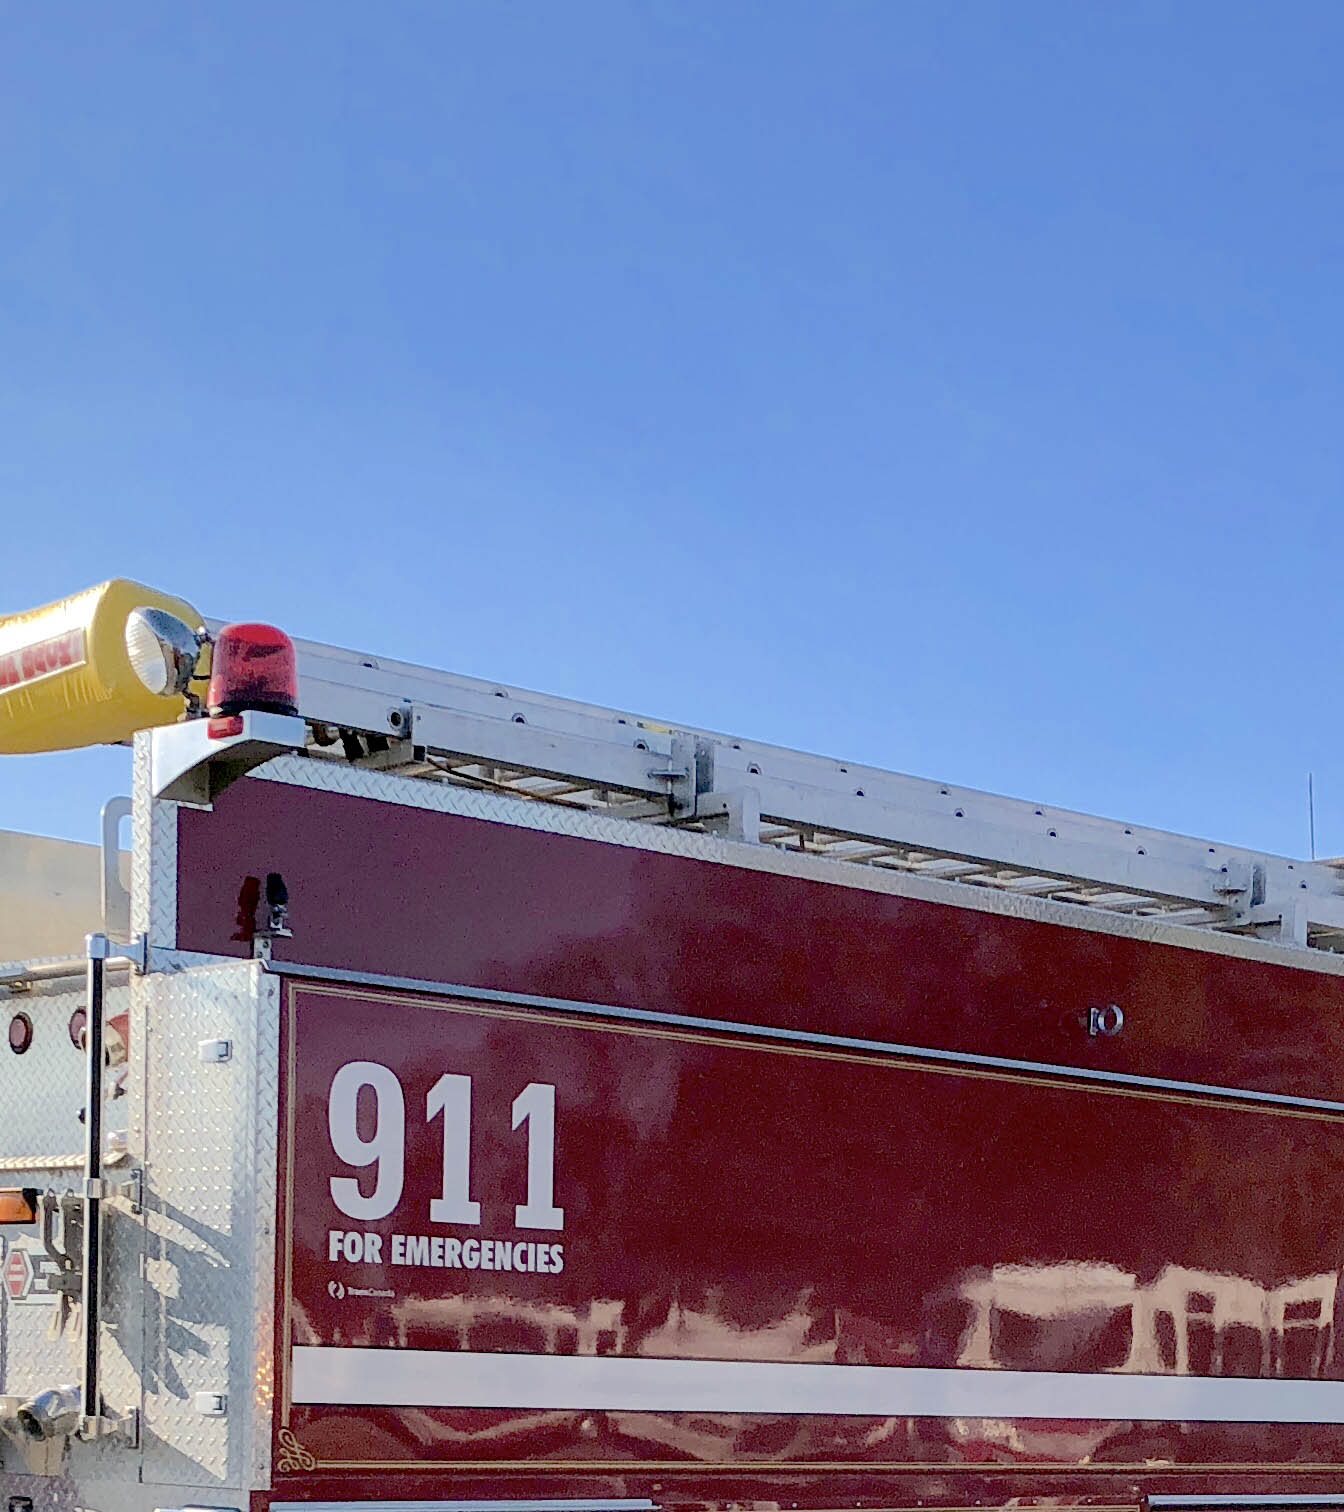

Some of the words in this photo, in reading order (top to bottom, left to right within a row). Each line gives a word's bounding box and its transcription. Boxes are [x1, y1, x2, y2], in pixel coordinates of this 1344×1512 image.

[329, 1061, 564, 1231] 911
[328, 1230, 383, 1264] FOR
[391, 1235, 564, 1274] EMERGENCIES
